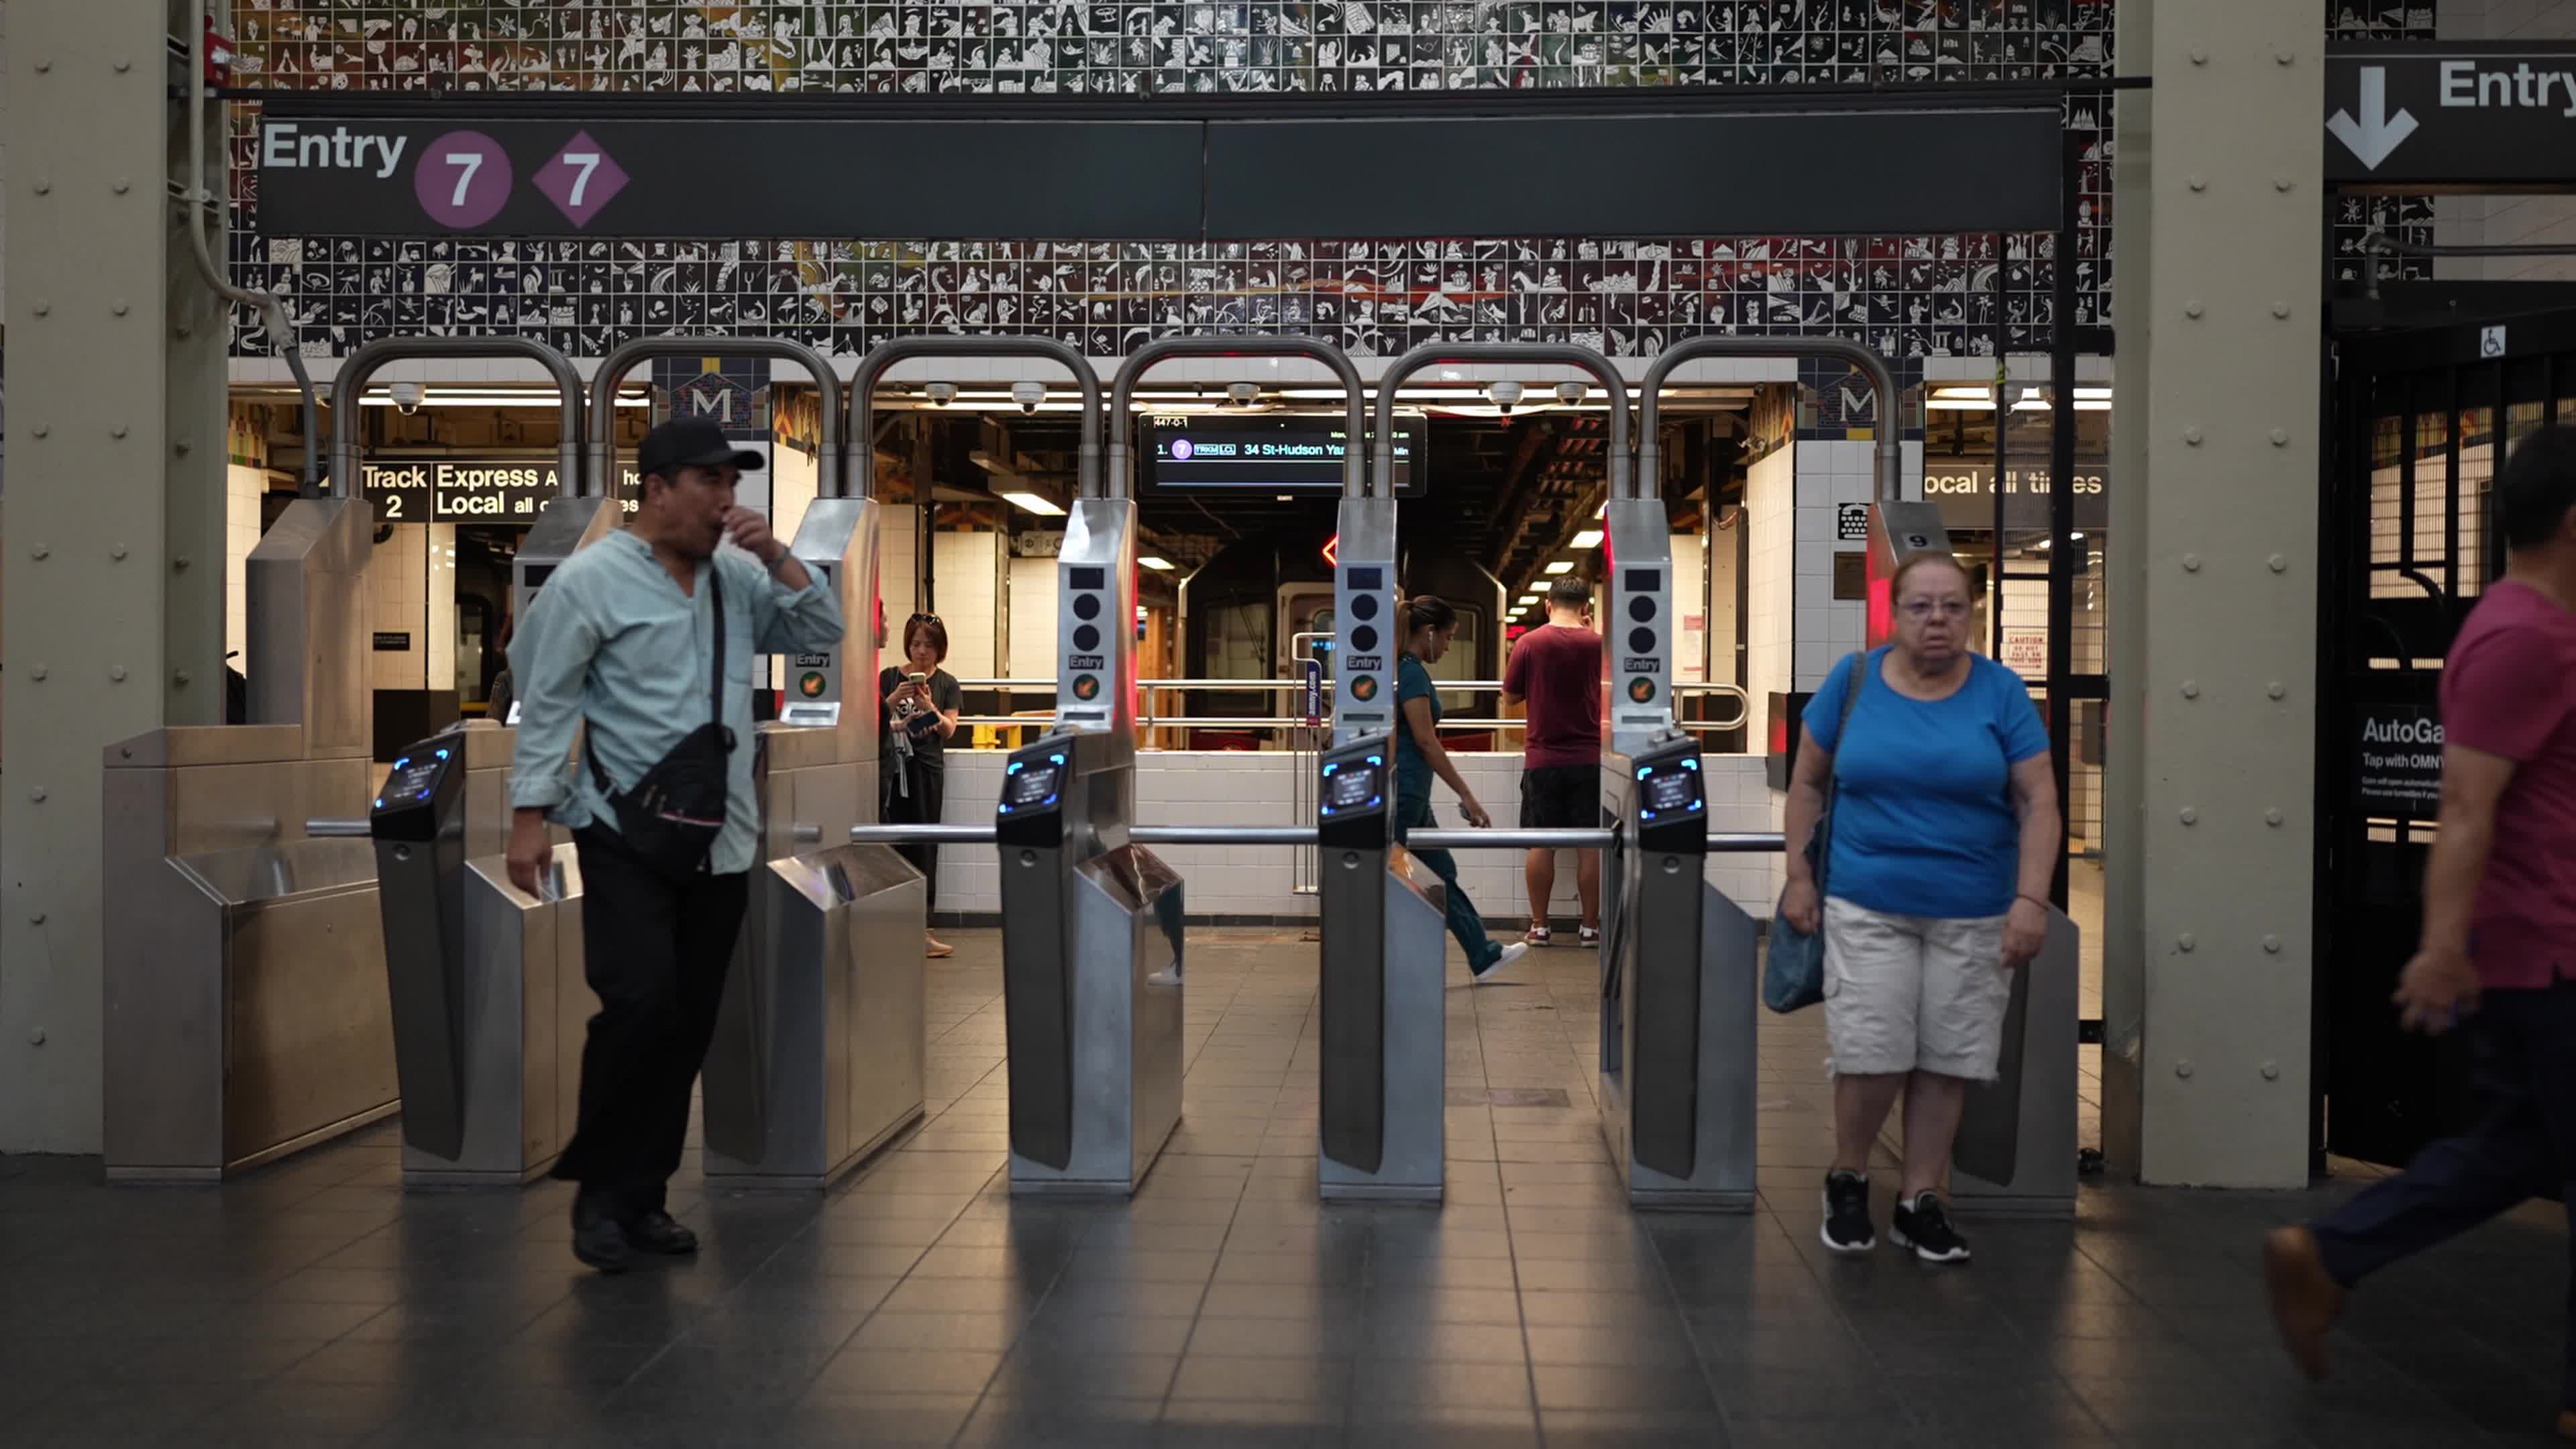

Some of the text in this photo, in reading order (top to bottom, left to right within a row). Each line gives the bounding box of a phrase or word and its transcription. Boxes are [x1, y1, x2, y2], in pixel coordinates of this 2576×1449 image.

[264, 123, 600, 207] Entry 7 7
[692, 388, 733, 423] M
[1840, 386, 1877, 422] M
[1157, 443, 1168, 455] 1.
[1244, 443, 1259, 455] 34
[1262, 443, 1324, 455] St-Hudson
[1326, 444, 1344, 455] Yar
[1394, 447, 1409, 455] Min
[362, 465, 427, 488] Track
[437, 464, 539, 492] Express
[1924, 471, 1978, 494] ocal
[2028, 471, 2102, 494] ties
[386, 494, 402, 518] 2
[437, 491, 504, 515] Local
[515, 496, 533, 513] all
[1909, 535, 1927, 548] 9
[796, 654, 829, 667] Entry
[1069, 656, 1104, 669] Entry
[1348, 656, 1381, 669] Entry
[1625, 659, 1660, 672] Entry
[1309, 671, 1318, 716] amny.com
[2363, 717, 2445, 743] AutoGa
[2363, 752, 2383, 769] Tap
[2385, 753, 2409, 768] with
